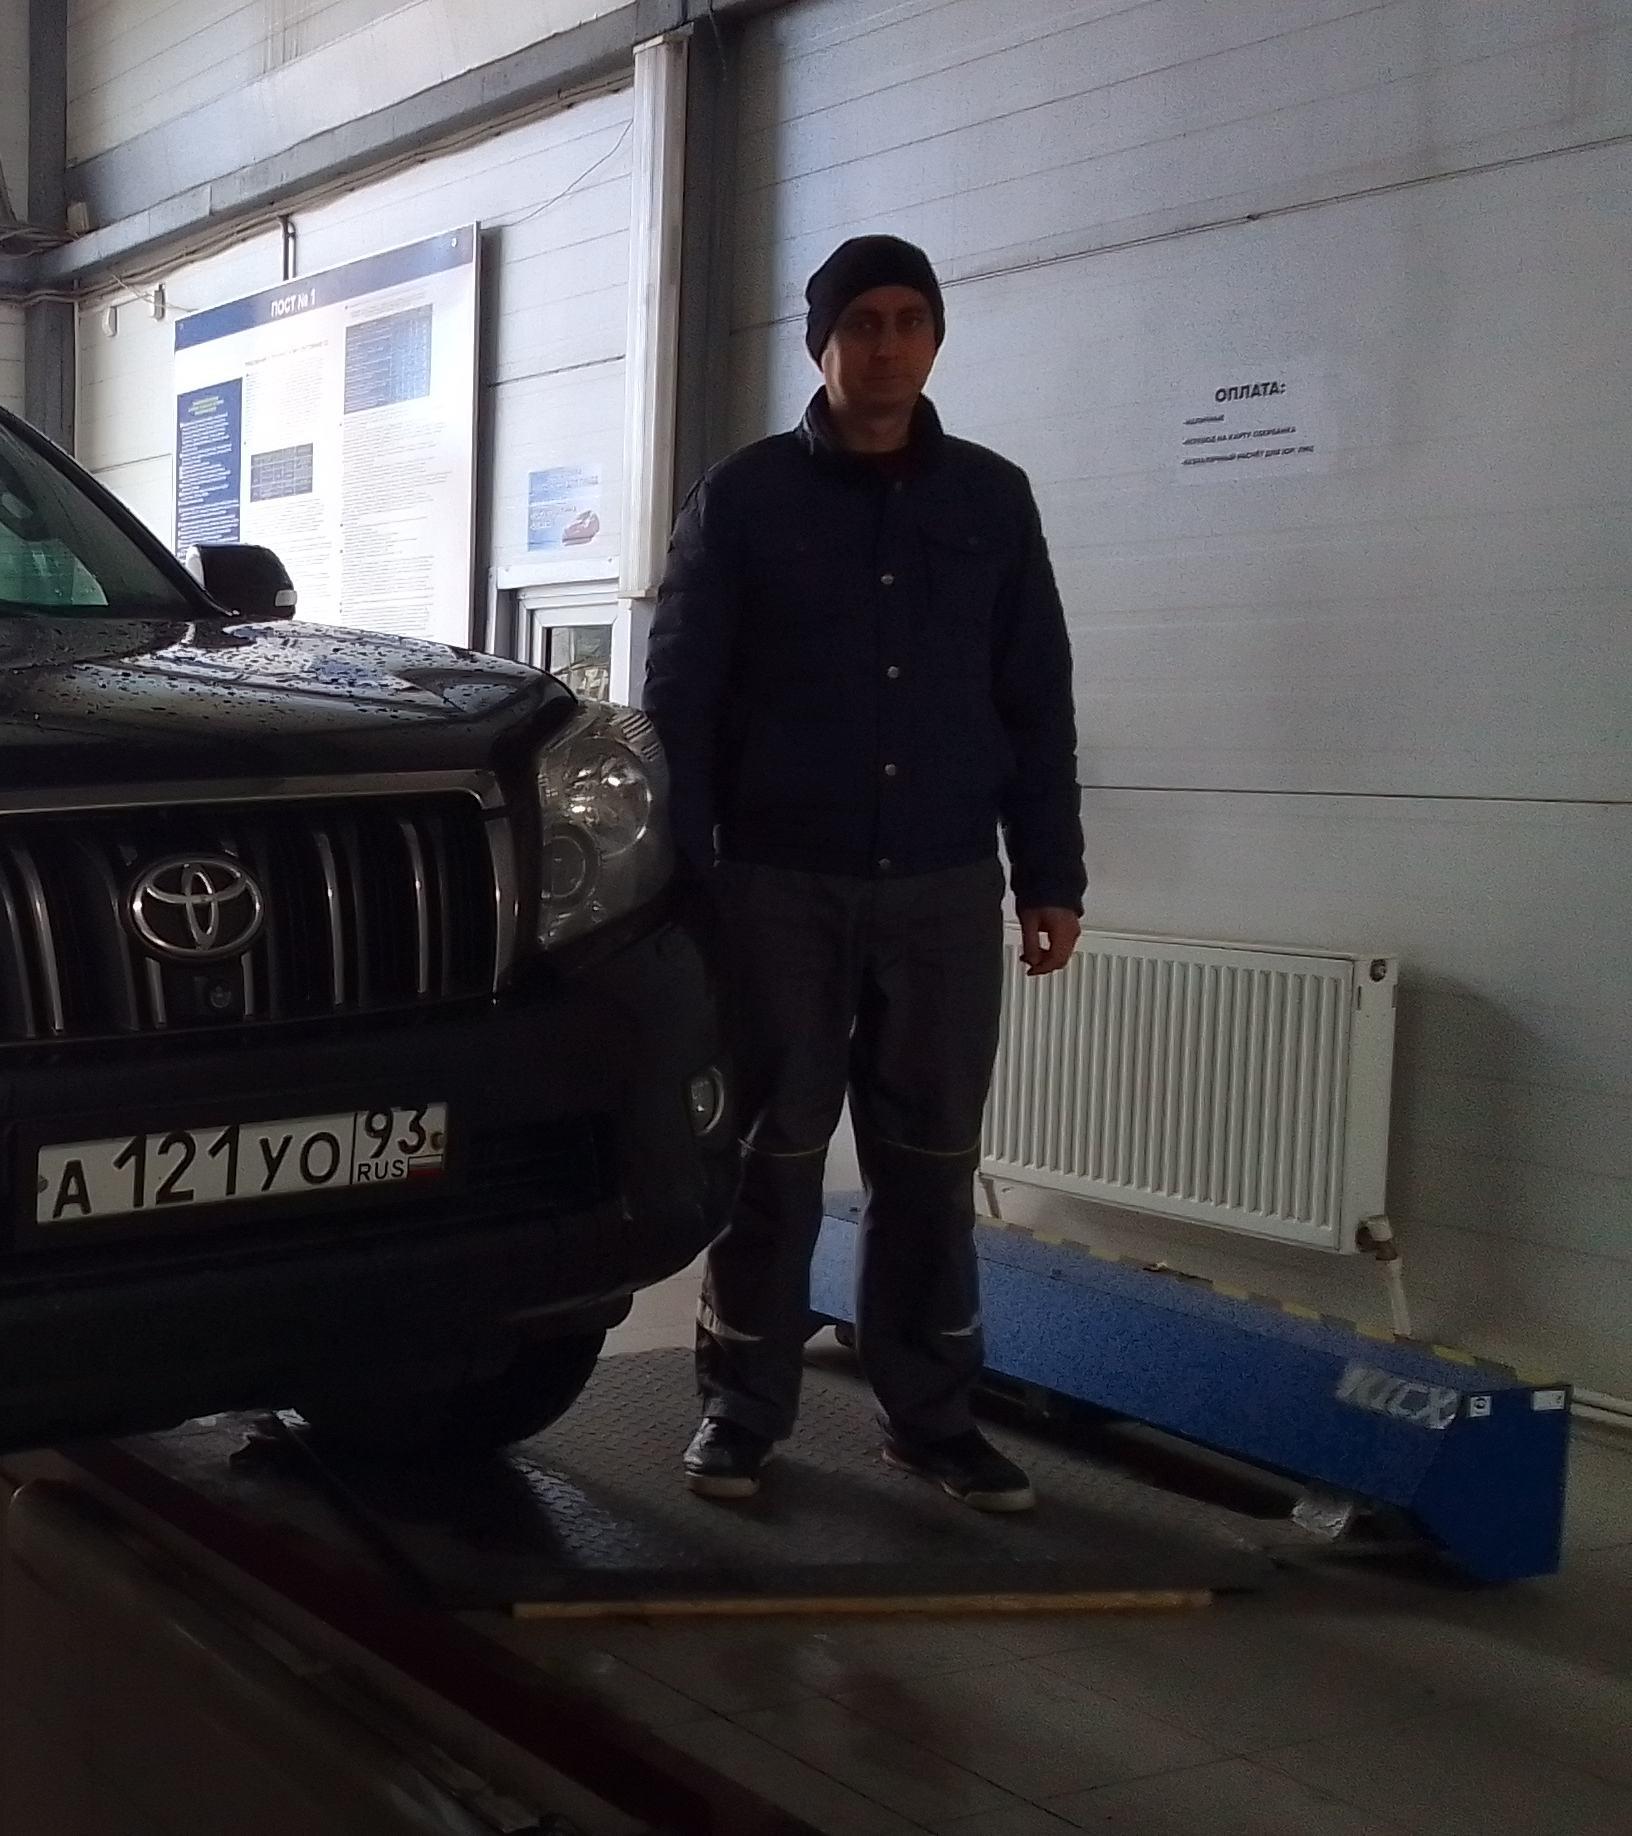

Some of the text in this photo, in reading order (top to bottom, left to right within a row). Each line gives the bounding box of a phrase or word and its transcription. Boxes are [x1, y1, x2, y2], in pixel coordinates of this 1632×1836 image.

[270, 295, 297, 318] ПОСТ
[1214, 381, 1286, 402] ОПЛАТА:
[364, 1104, 428, 1159] 93
[357, 1159, 405, 1182] RUS
